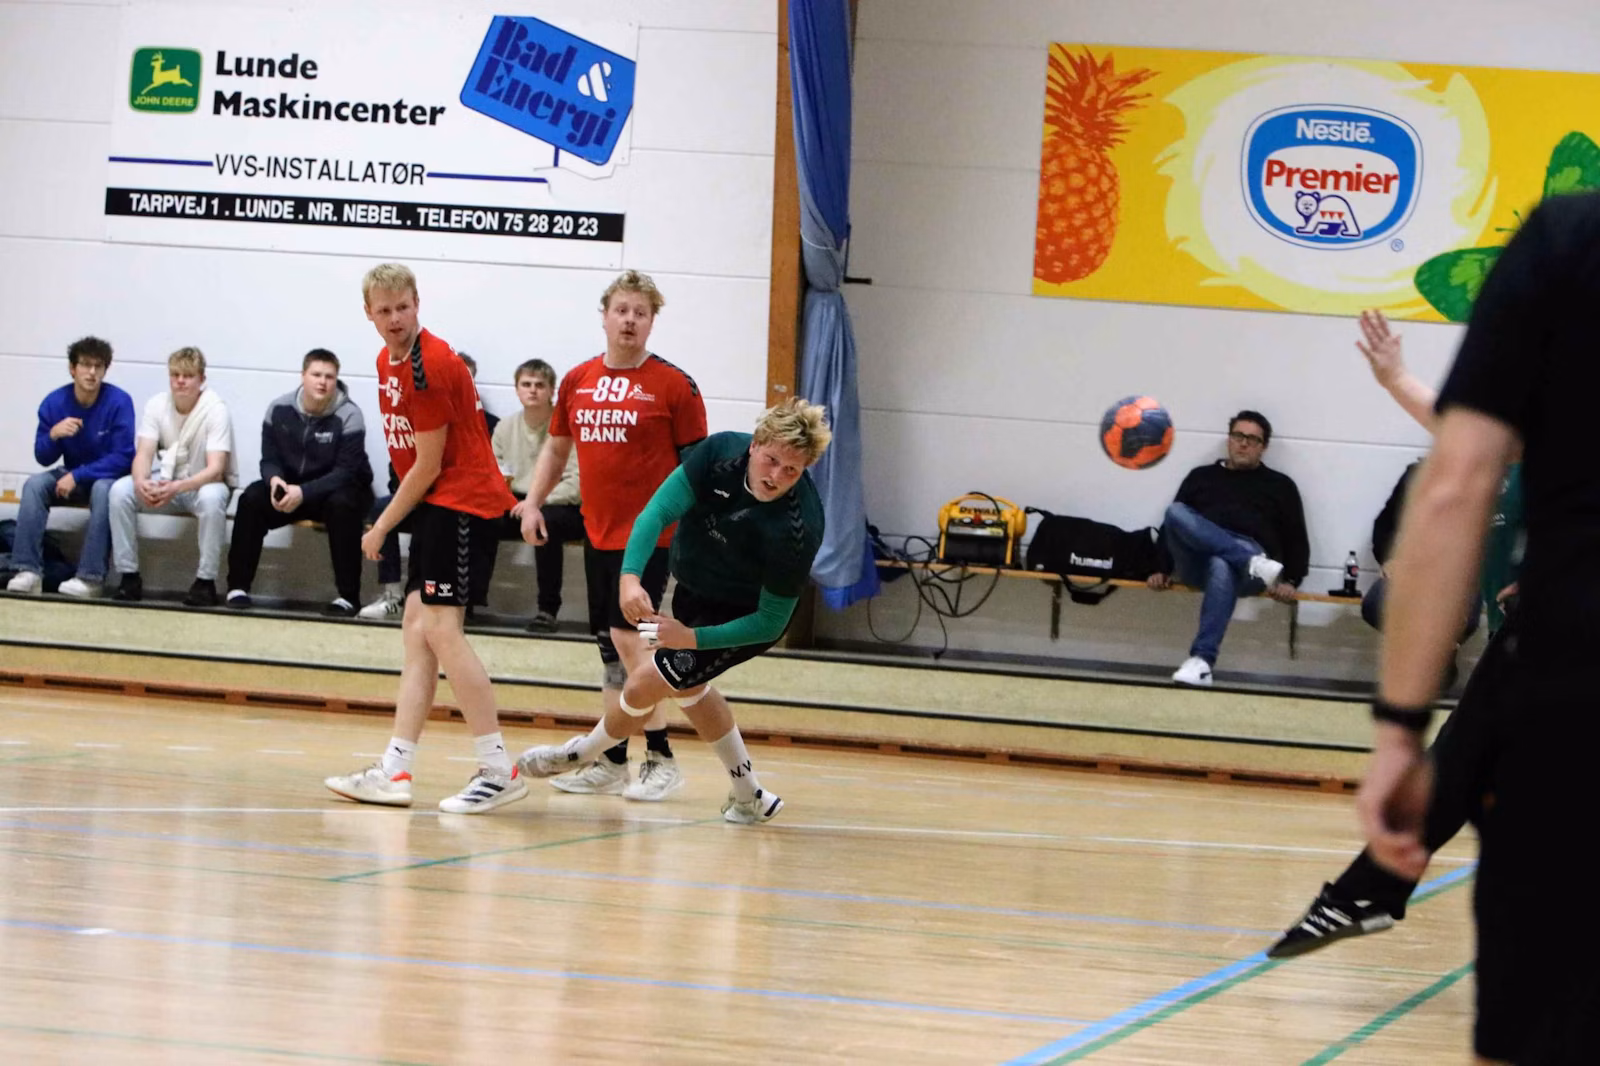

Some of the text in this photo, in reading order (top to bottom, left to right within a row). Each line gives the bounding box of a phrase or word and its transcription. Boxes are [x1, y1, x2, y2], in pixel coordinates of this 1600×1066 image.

[216, 50, 318, 79] Lunde
[491, 17, 612, 102] Bad &
[134, 95, 194, 107] JOHN DEERE
[213, 90, 446, 126] Maskincenter
[475, 56, 616, 147] Energi
[215, 154, 425, 186] VVS-INSTALLATØR
[1265, 159, 1399, 194] Premier
[129, 193, 206, 215] TARPVEJ
[234, 198, 295, 220] LUNDE
[308, 202, 338, 222] NR.
[343, 204, 402, 226] NEBEL
[417, 207, 499, 231] TELEFON
[503, 213, 524, 232] 75
[528, 214, 549, 234] 28
[552, 216, 574, 235] 20
[577, 217, 599, 236] 23
[592, 376, 630, 402] 89
[575, 408, 638, 426] SKJERN
[580, 426, 628, 443] BANK
